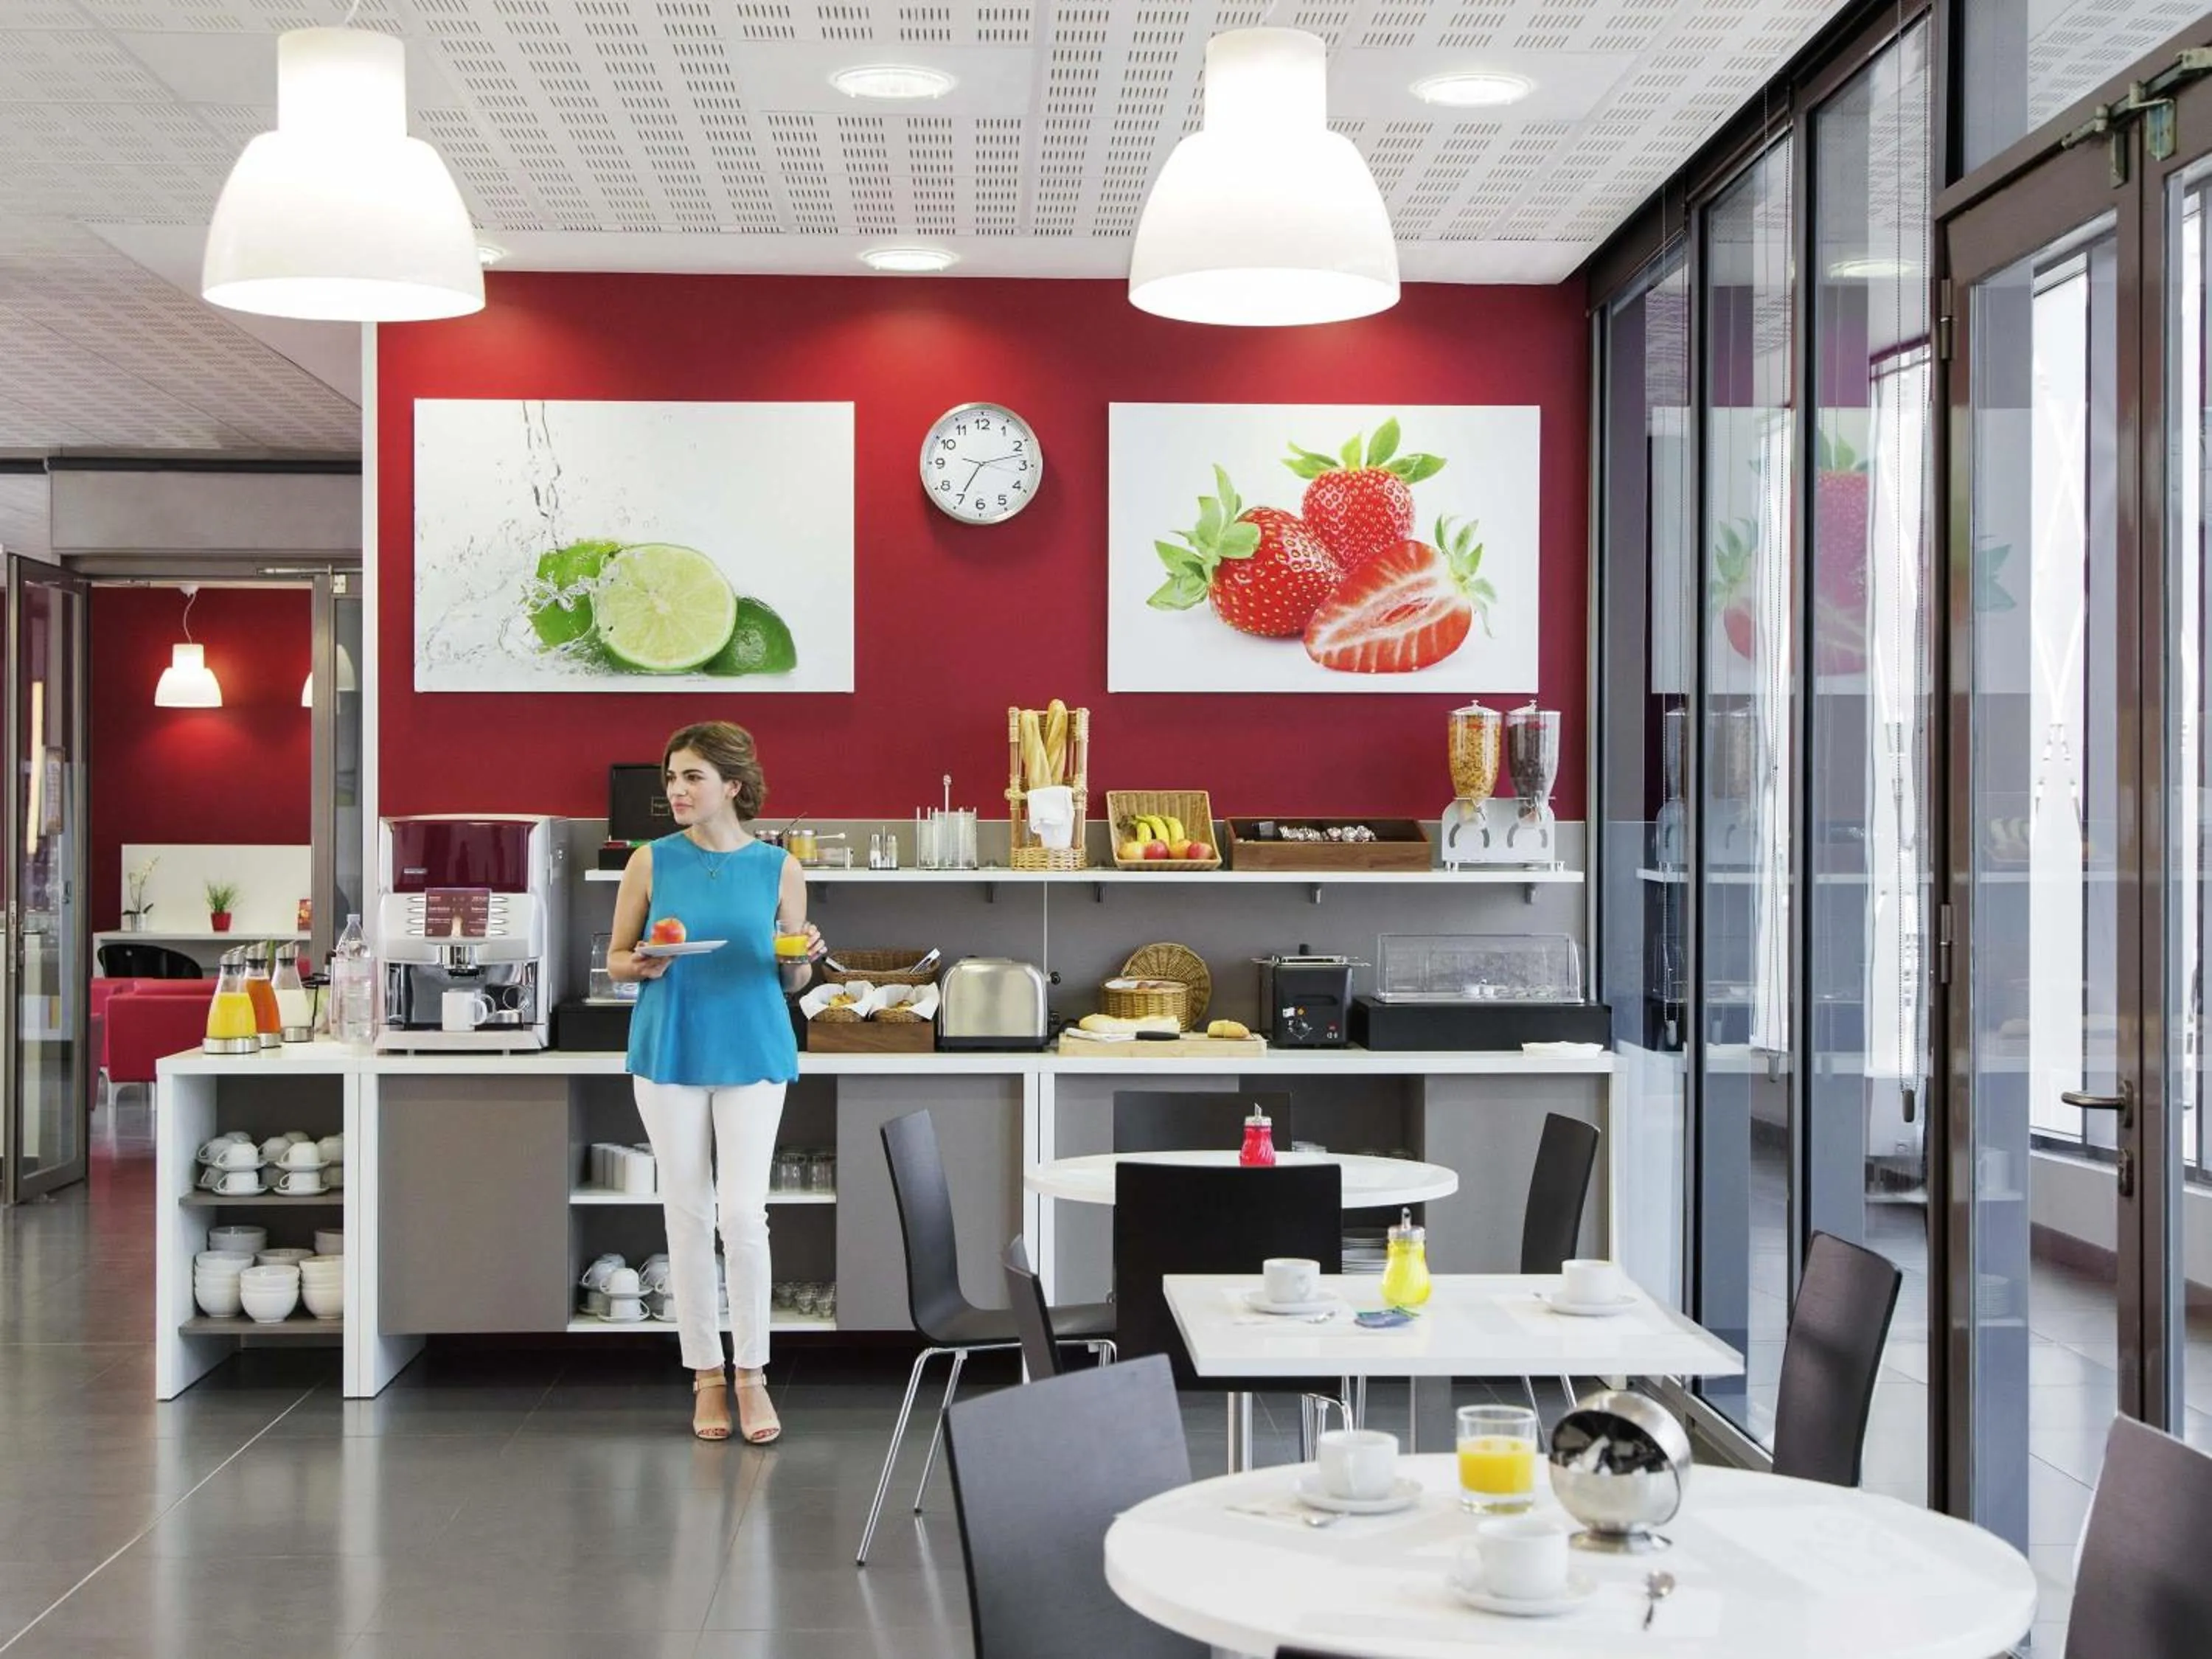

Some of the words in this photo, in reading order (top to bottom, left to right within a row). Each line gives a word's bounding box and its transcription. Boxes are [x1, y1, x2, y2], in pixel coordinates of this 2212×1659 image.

[974, 418, 990, 431] 12
[956, 425, 967, 436] 11
[1001, 426, 1006, 436] 1
[941, 439, 956, 451] 10
[1012, 440, 1023, 452] 2
[935, 458, 945, 470] 9
[1019, 460, 1027, 471] 3
[940, 480, 950, 491] 8
[1012, 480, 1021, 490] 4
[956, 494, 965, 505] 7
[975, 498, 986, 510] 6
[998, 495, 1007, 506] 5
